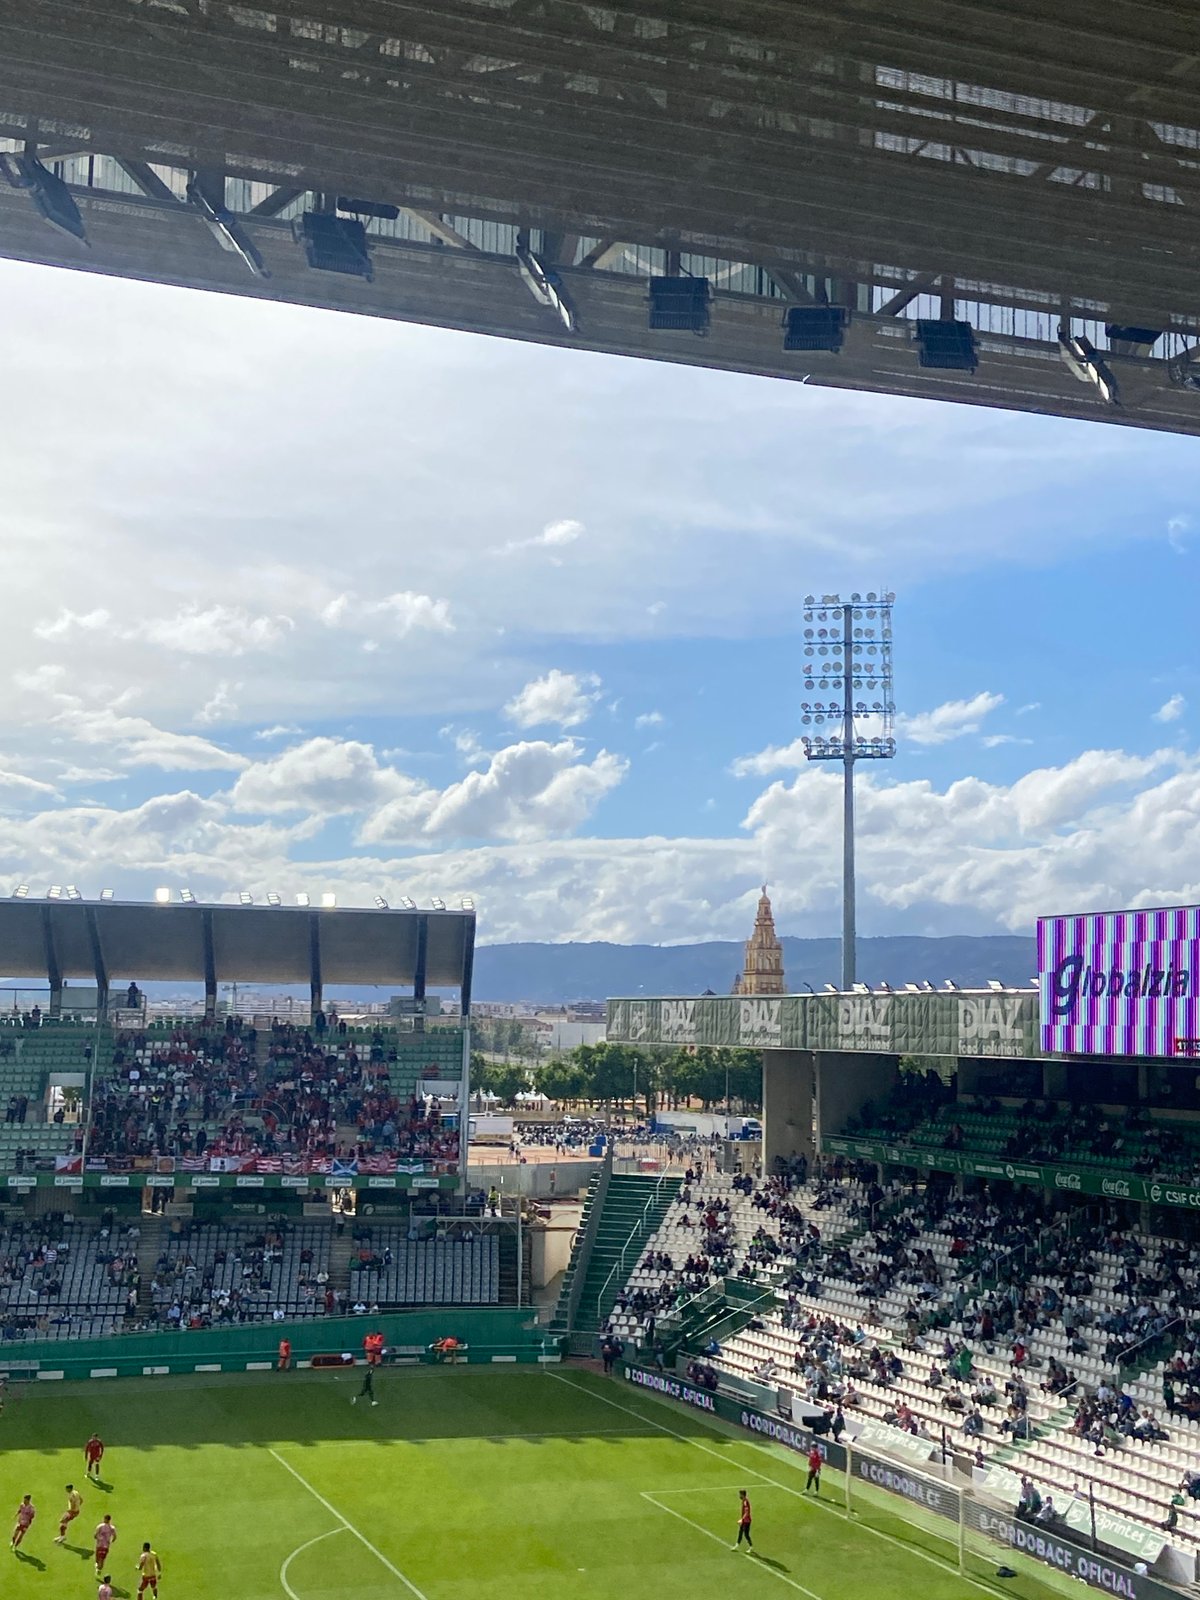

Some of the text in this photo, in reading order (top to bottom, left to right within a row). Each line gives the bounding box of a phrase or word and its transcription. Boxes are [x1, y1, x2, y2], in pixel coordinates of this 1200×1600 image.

[1052, 953, 1189, 1016] globalzia
[661, 1000, 695, 1031] DIAZ
[740, 1000, 781, 1033] DIAZ
[838, 999, 891, 1036] DIAZ
[958, 999, 1024, 1039] DIAZ
[958, 1039, 1023, 1056] food solutions
[1166, 1190, 1187, 1204] CSIF
